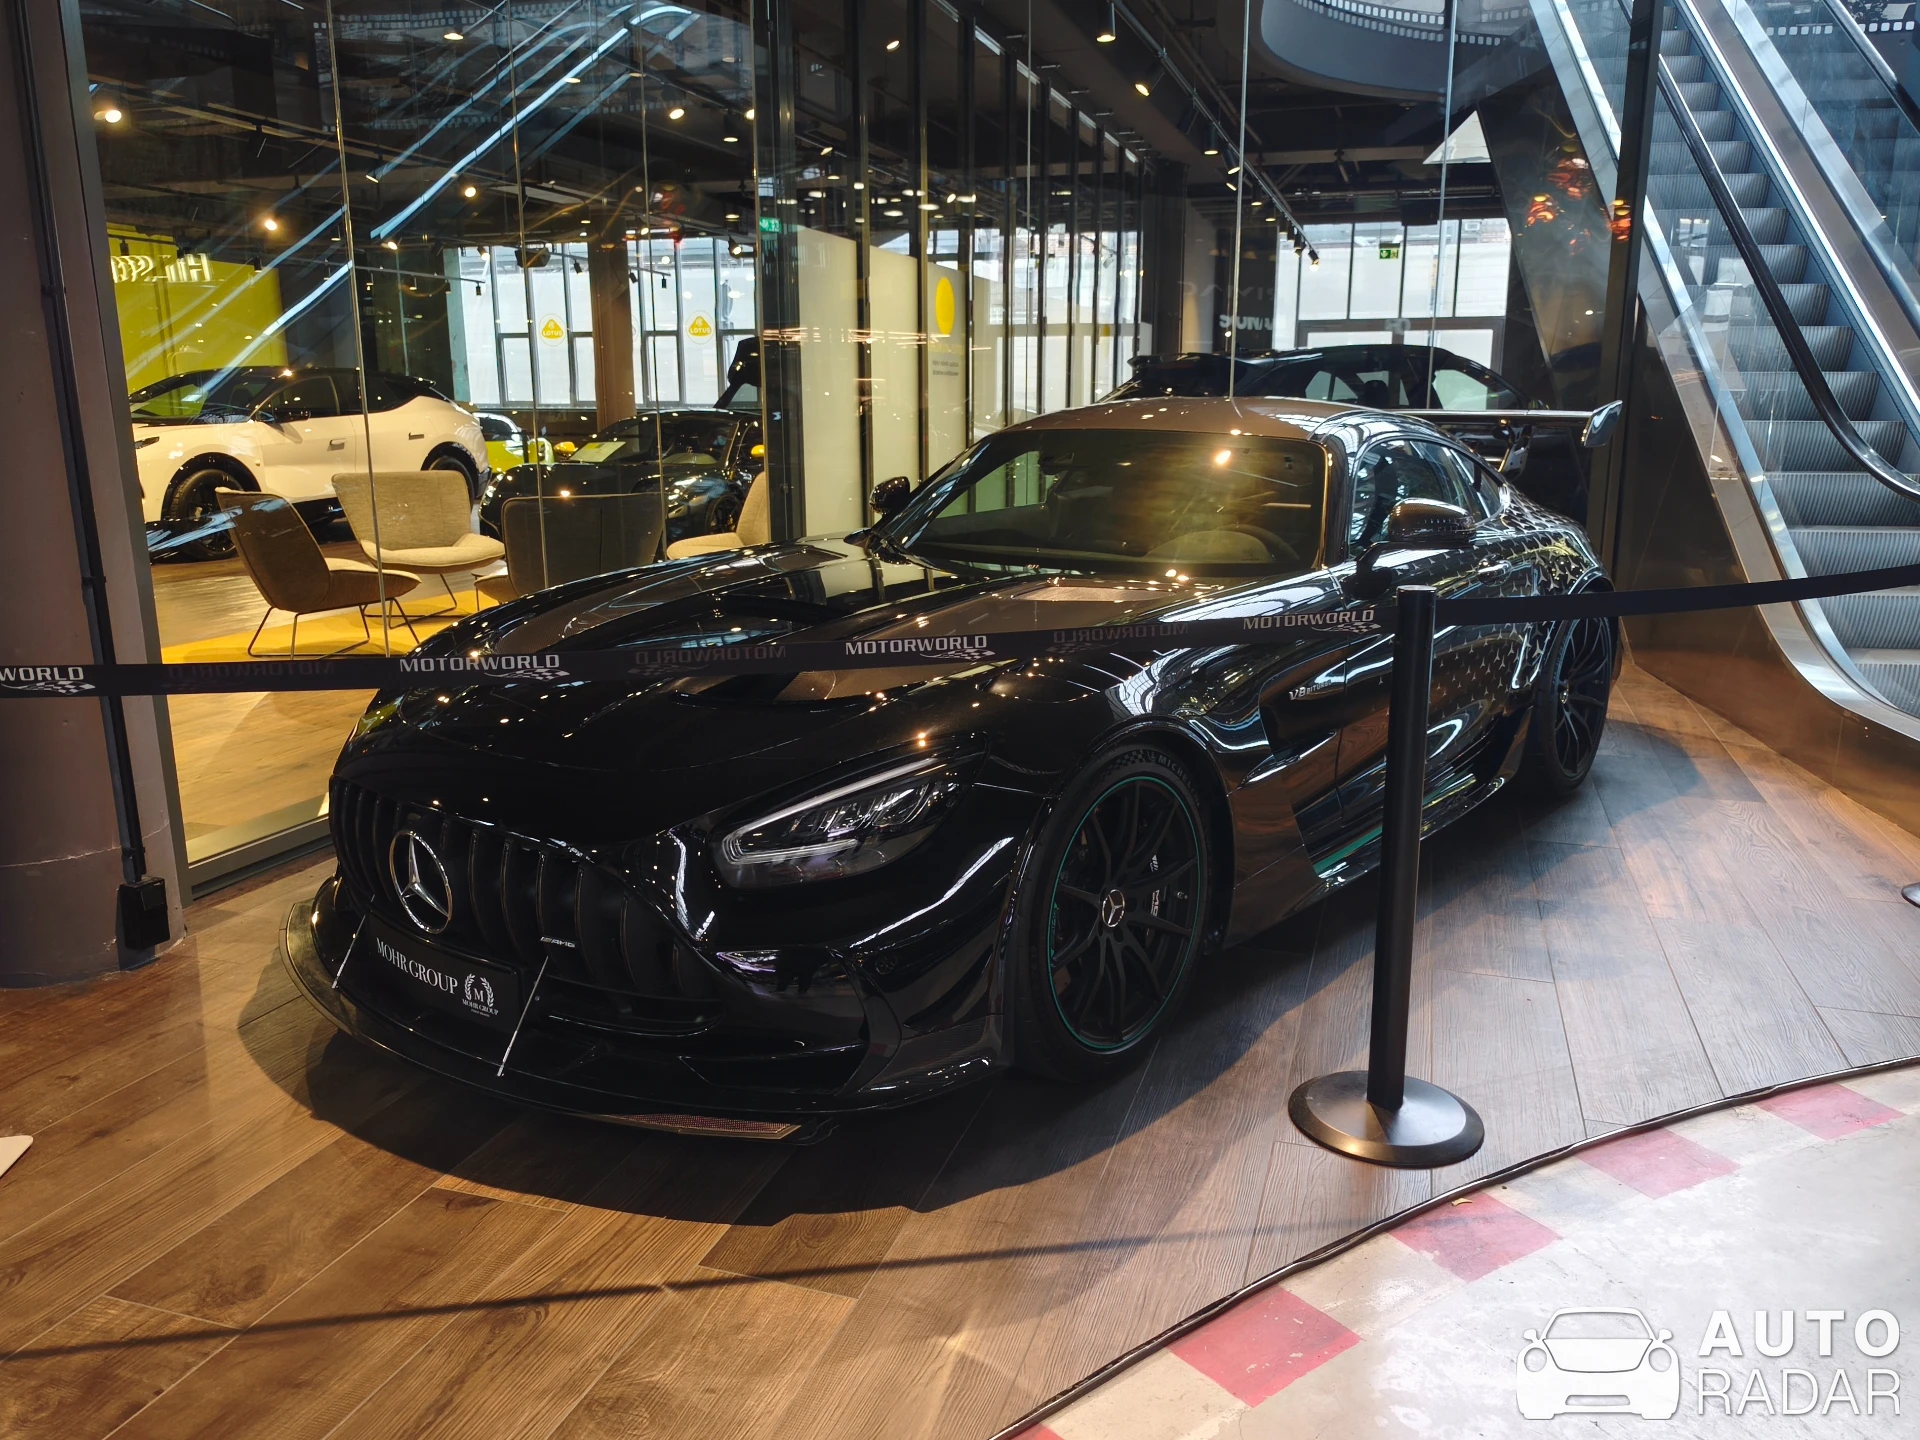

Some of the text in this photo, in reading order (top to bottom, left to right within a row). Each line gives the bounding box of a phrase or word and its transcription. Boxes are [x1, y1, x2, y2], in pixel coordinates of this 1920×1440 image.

[542, 329, 563, 337] LOTUS
[690, 327, 712, 335] LOTUS
[1243, 609, 1375, 630] MOTORWORLD
[845, 635, 988, 656] MOTORWORLD
[400, 654, 560, 672] MOTORWORLD
[1289, 686, 1306, 701] V8
[551, 938, 576, 948] AMG
[376, 937, 458, 995] MOHR GROUP
[473, 988, 485, 1003] M
